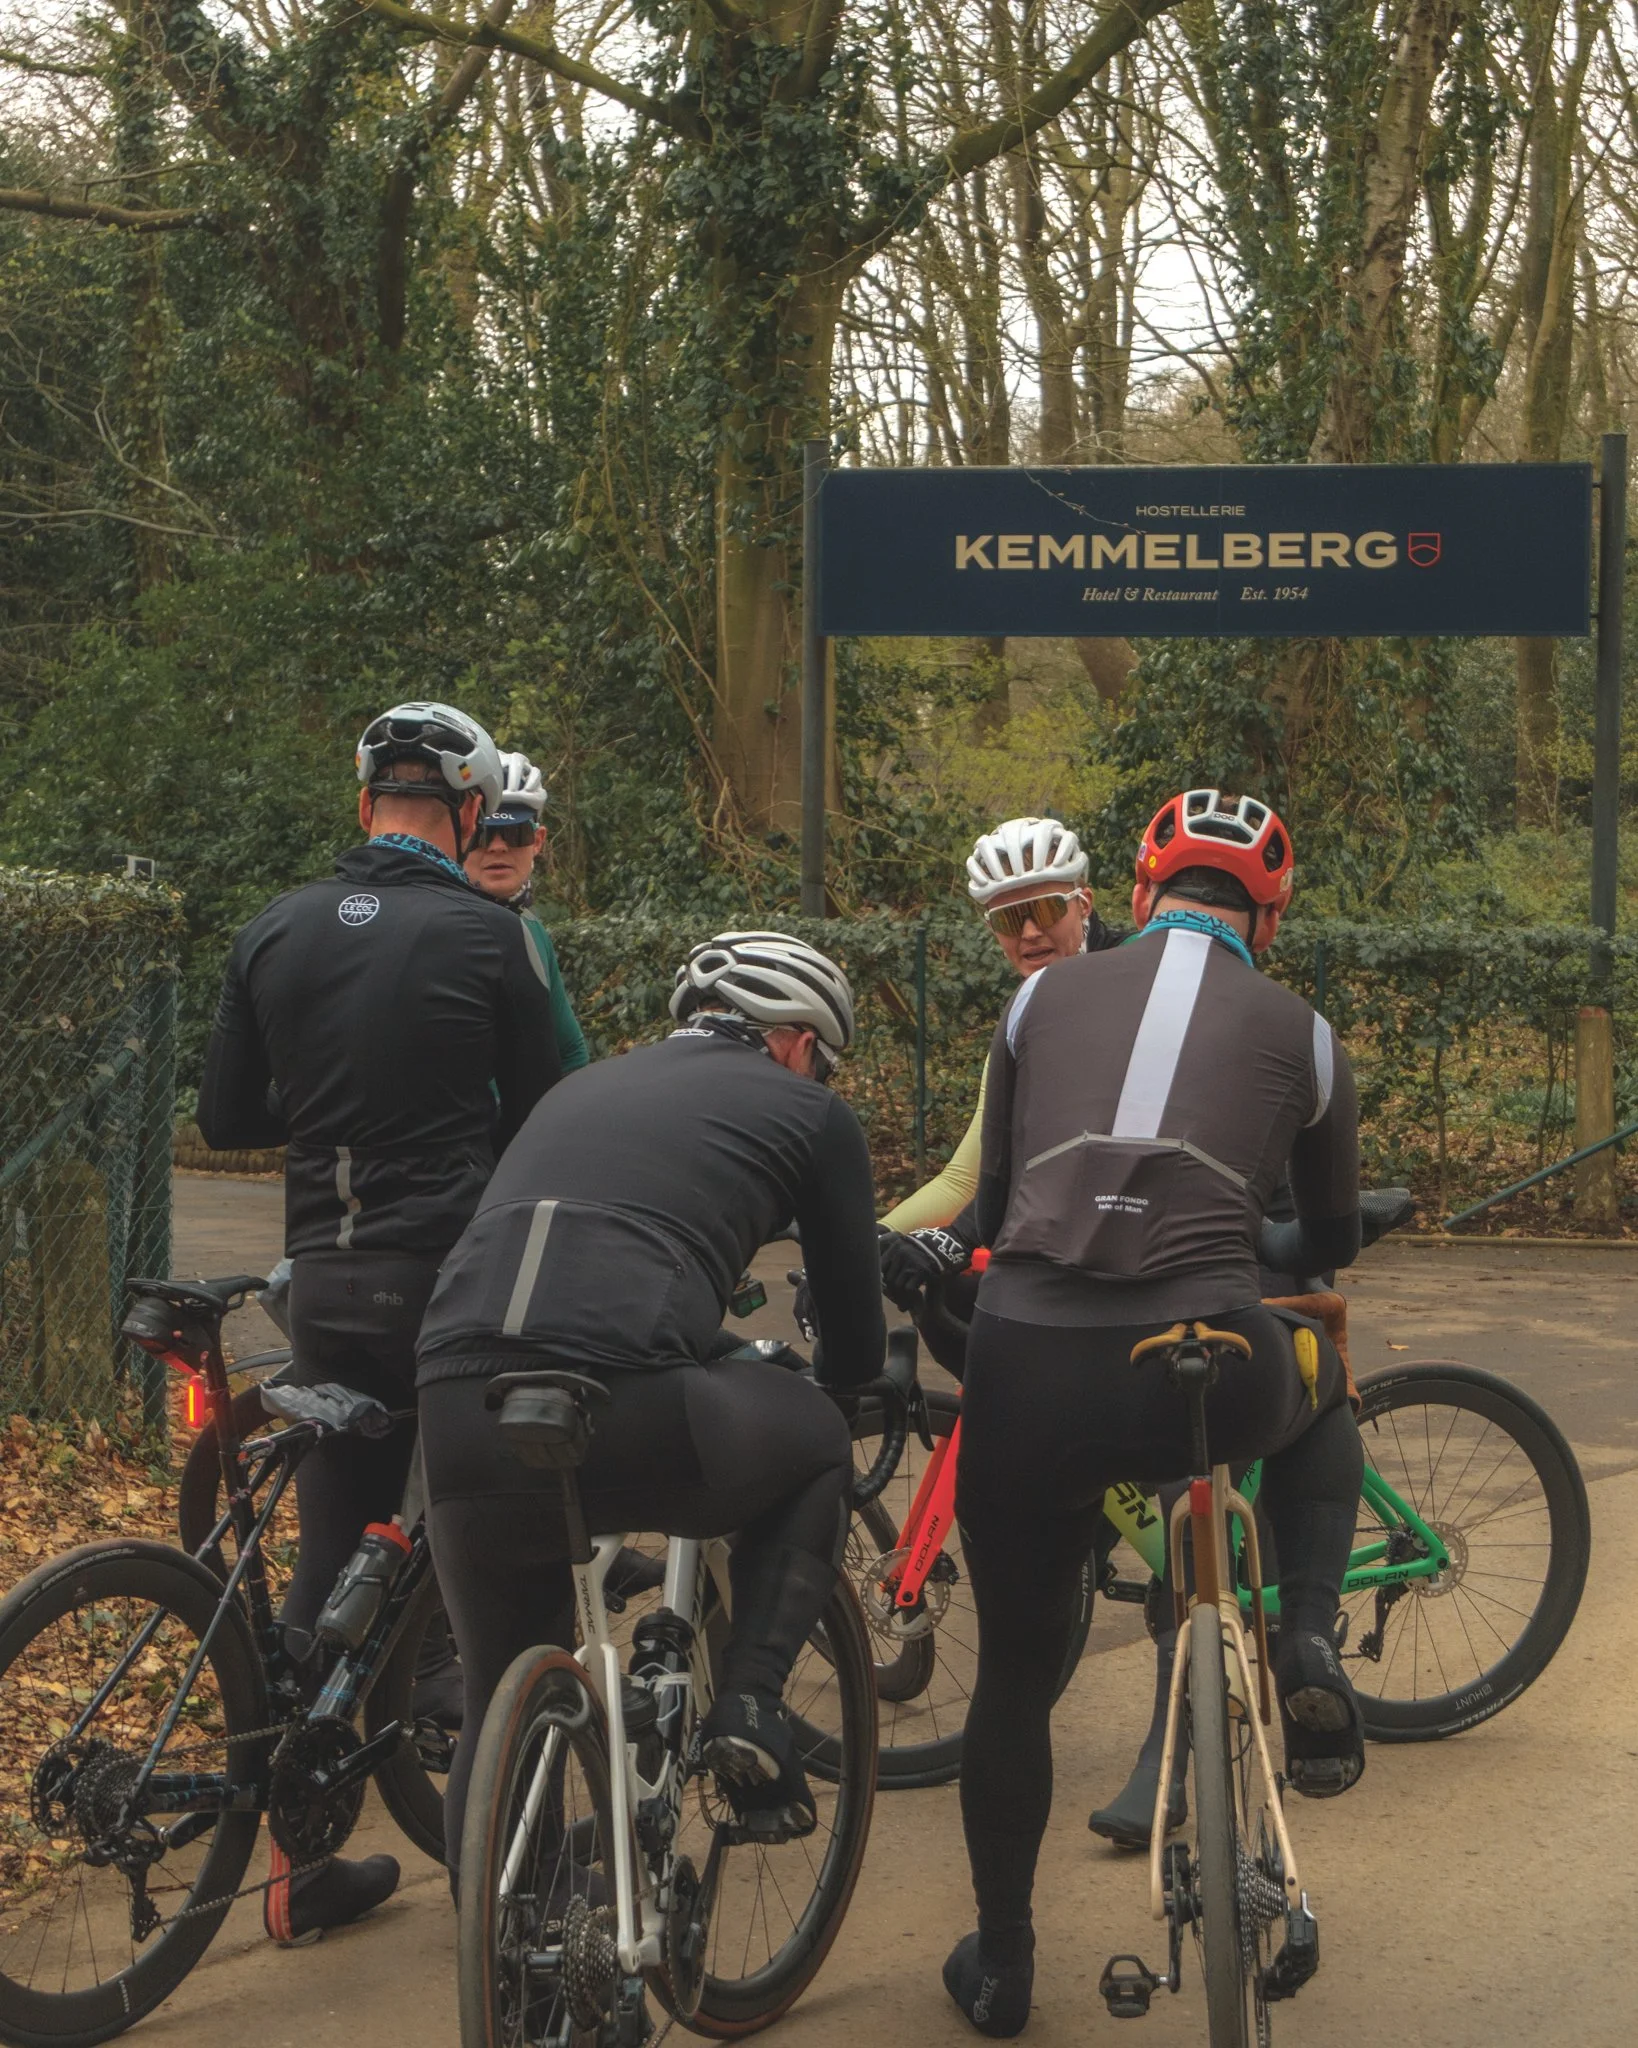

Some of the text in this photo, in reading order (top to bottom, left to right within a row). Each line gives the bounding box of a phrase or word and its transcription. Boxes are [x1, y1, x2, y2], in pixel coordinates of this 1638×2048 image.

[1135, 505, 1246, 516] HOSTELLERIE
[955, 531, 1398, 570] KEMMELBERG
[1082, 586, 1309, 601] Hotel & Restaurant Est. 1954
[1094, 1194, 1149, 1205] GRAN FONDO
[1124, 1205, 1143, 1213] Man
[373, 1291, 404, 1306] dhb
[914, 1515, 940, 1572] DOLAN
[1347, 1570, 1409, 1588] DOLAN
[580, 1574, 596, 1635] TARMAC
[1455, 1688, 1484, 1712] HUNT
[1460, 1698, 1504, 1728] PIRELLI
